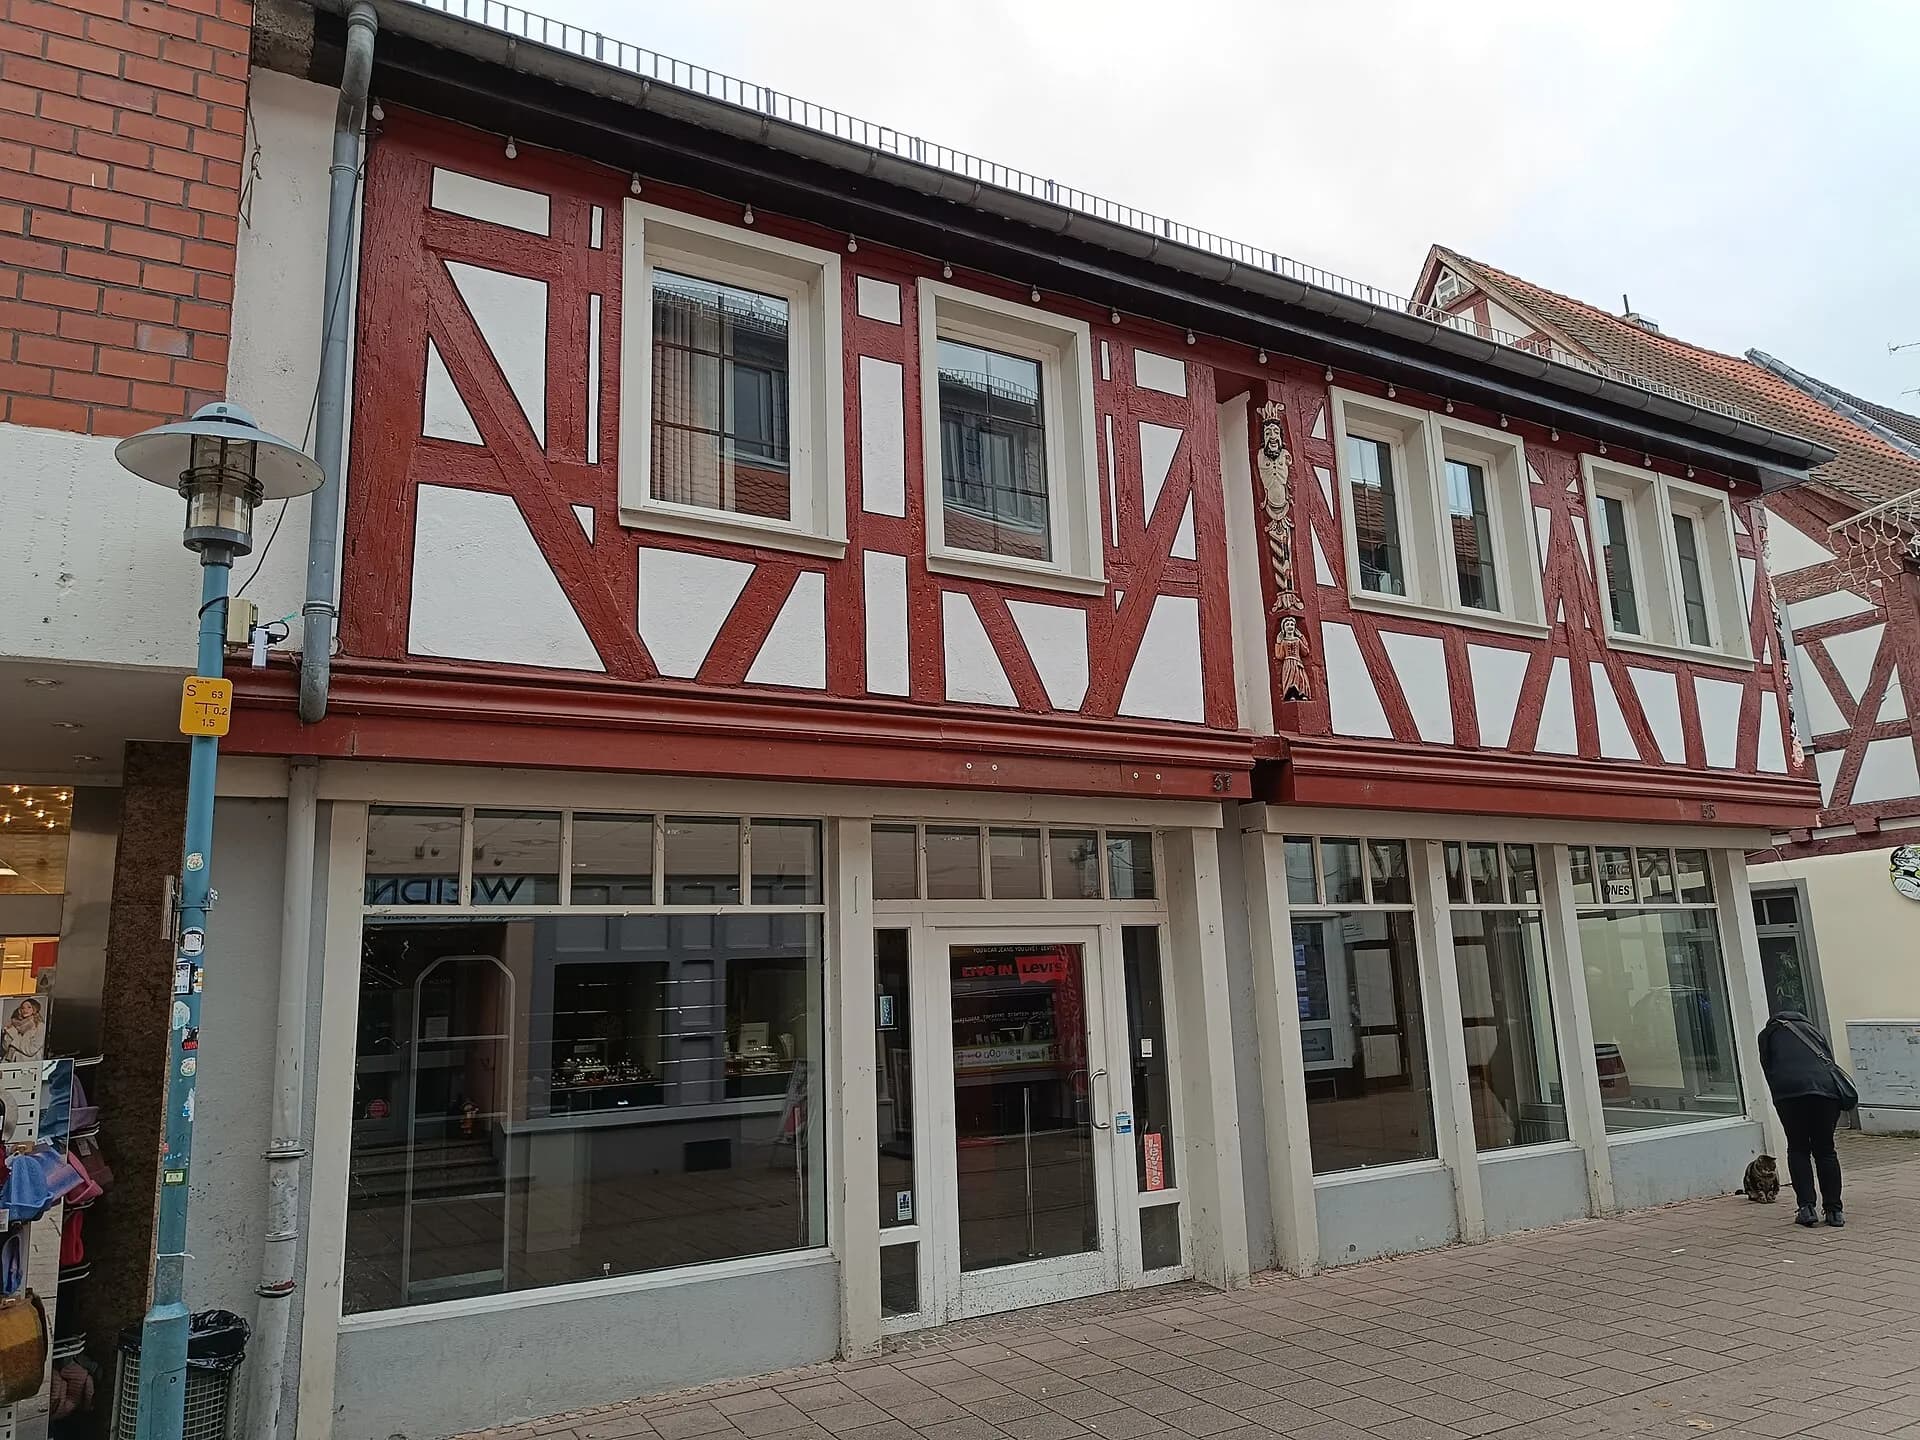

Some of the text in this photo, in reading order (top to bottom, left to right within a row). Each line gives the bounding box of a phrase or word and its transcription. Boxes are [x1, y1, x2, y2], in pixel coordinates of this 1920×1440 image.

[186, 684, 224, 699] S 63
[998, 963, 1013, 976] IN
